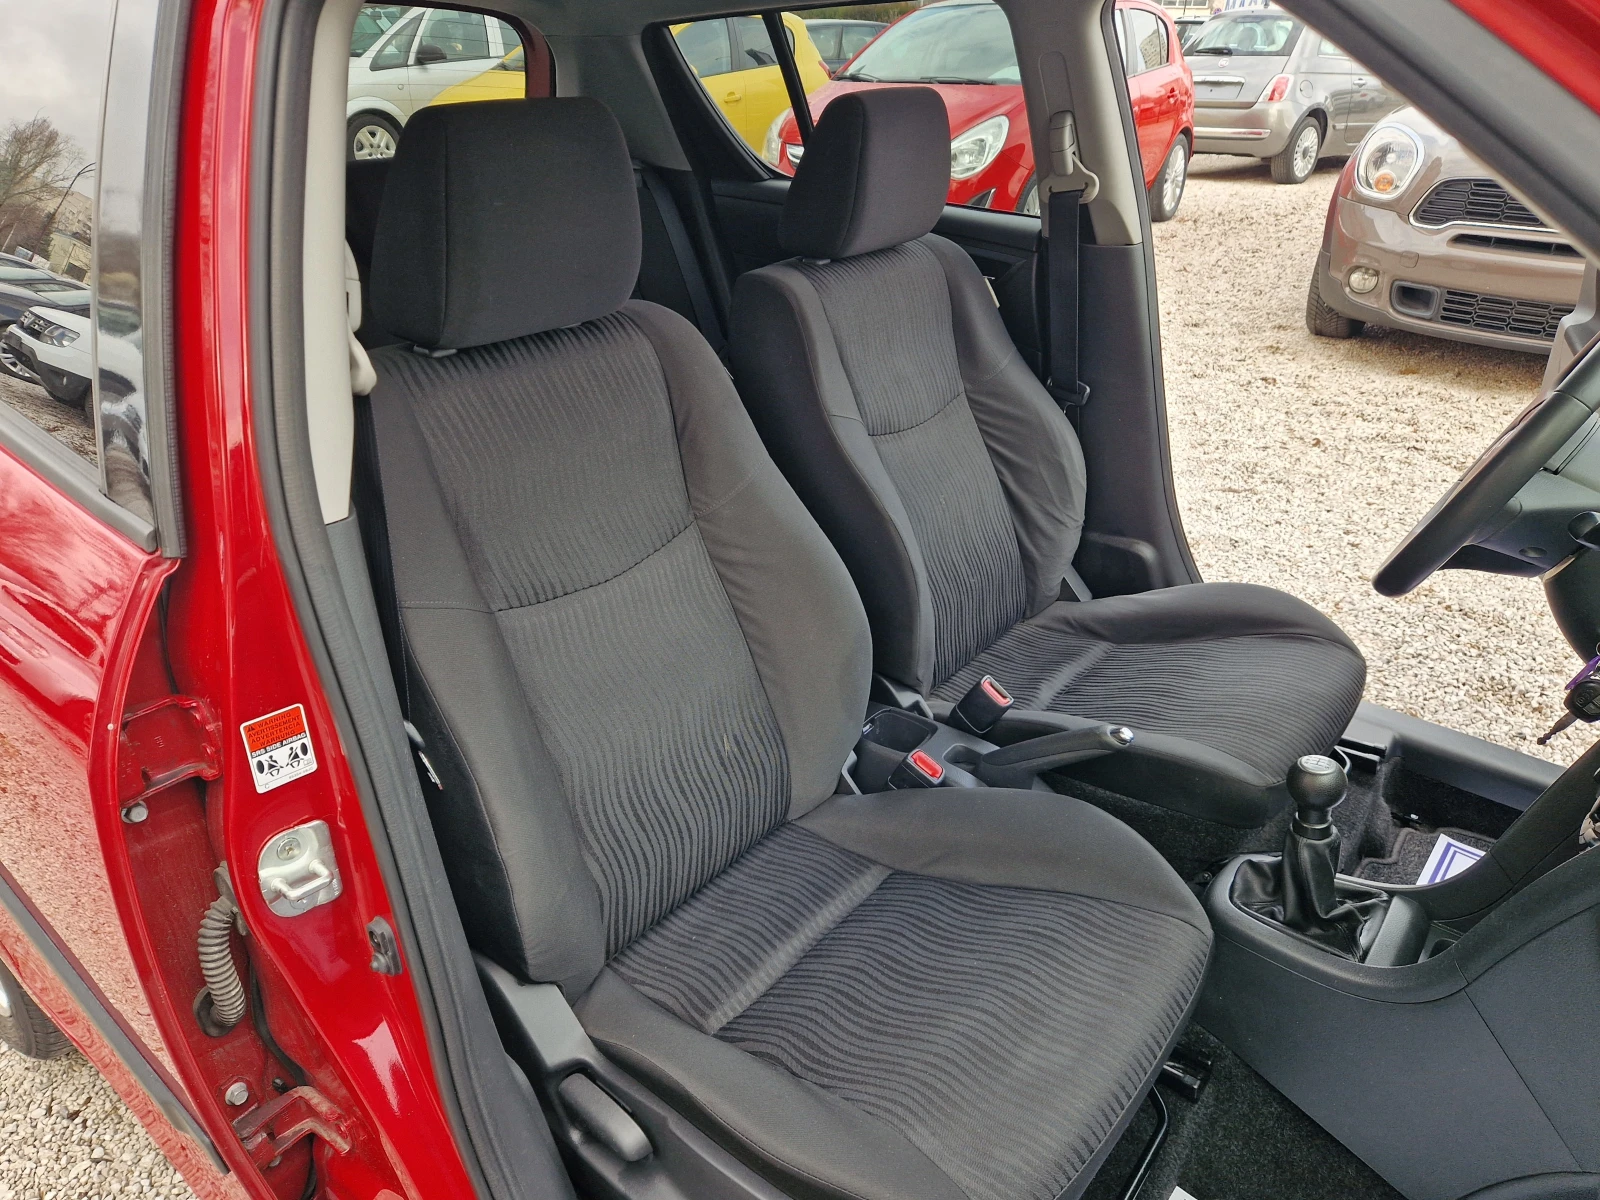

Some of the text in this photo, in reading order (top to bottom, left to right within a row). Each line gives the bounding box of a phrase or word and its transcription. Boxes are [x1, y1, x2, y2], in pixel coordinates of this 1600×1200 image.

[248, 715, 301, 739] AVERTISSEMENT
[257, 712, 292, 729] WARNING
[251, 721, 301, 744] ADVERTENCIA
[260, 729, 296, 747] WARNUNG
[251, 732, 307, 758] SRS SIDE AIRBAG
